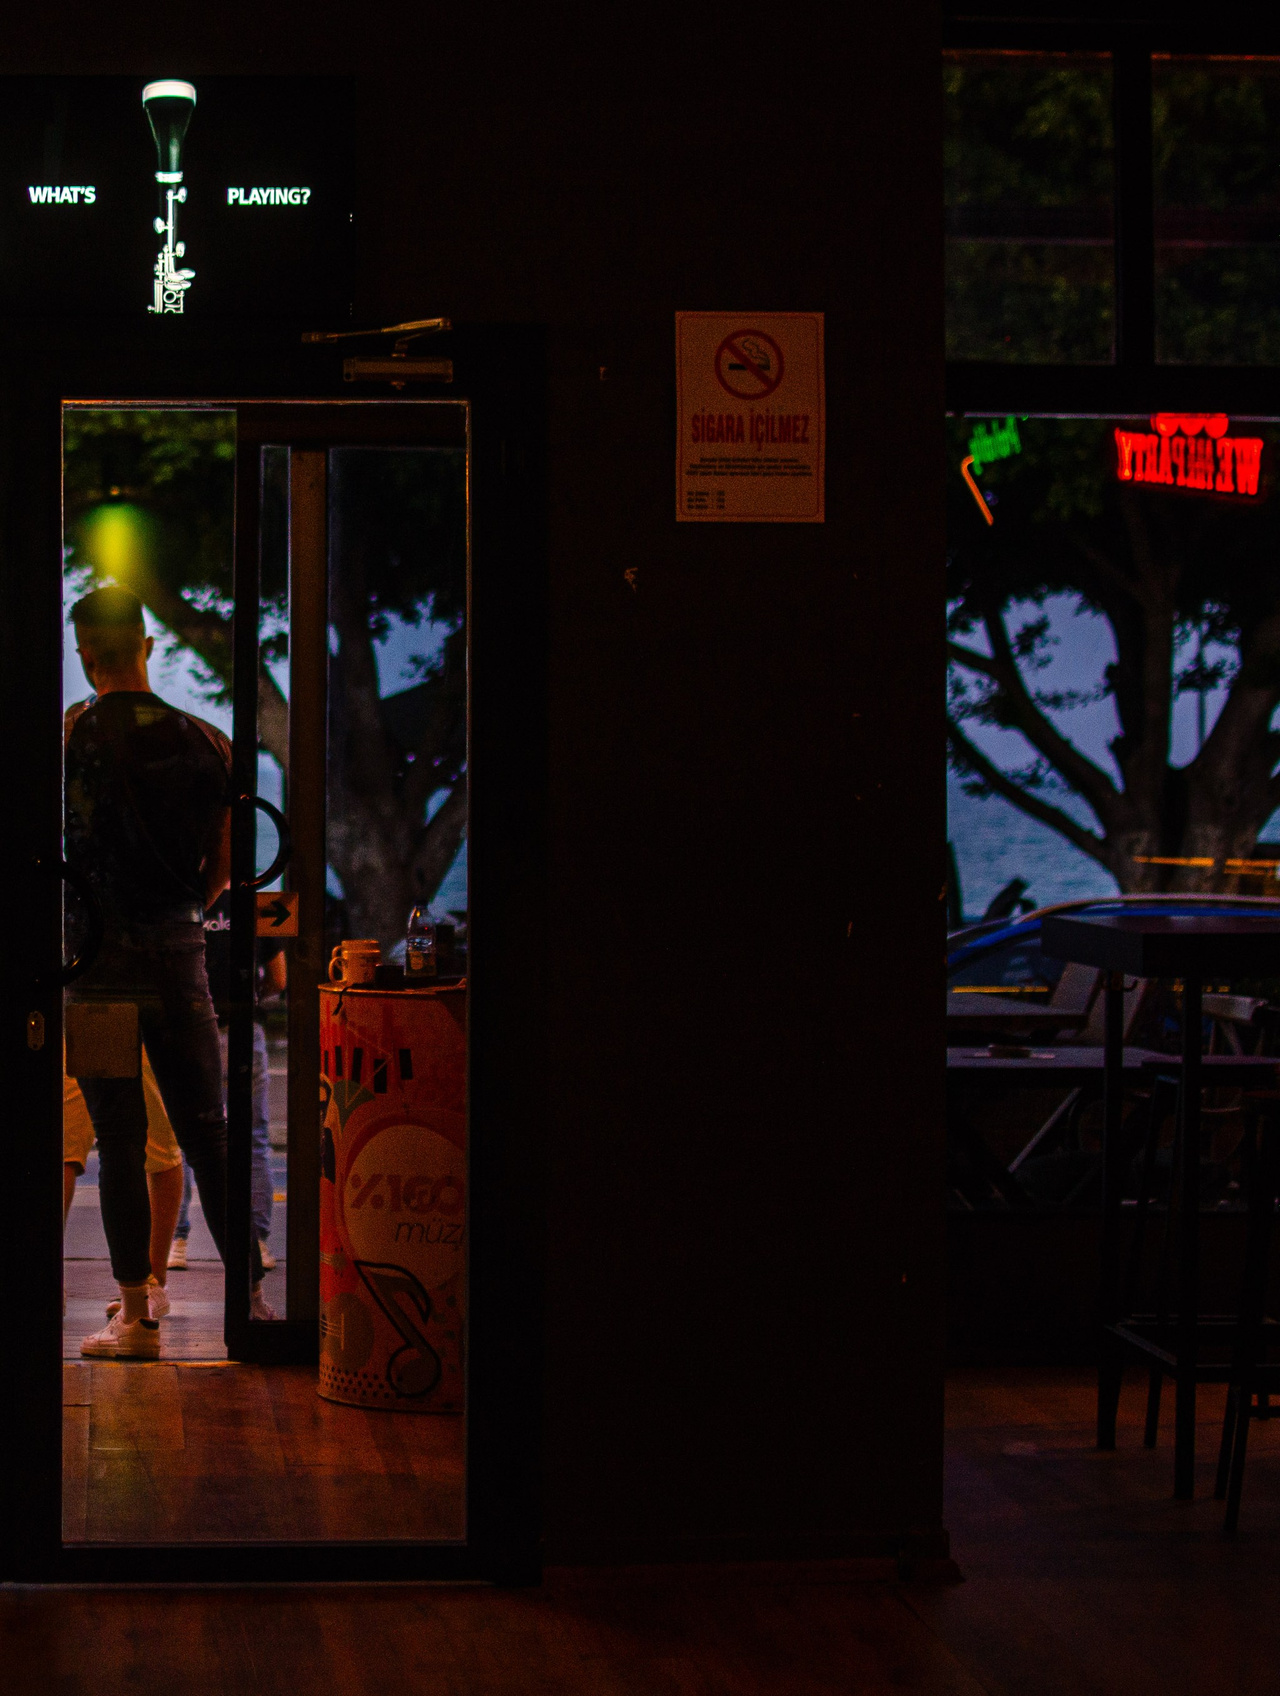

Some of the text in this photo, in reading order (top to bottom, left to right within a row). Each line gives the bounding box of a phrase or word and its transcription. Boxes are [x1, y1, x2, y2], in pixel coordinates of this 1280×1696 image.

[28, 186, 96, 204] WHAT'S
[227, 187, 311, 205] PLAYING?
[691, 407, 809, 451] SİGARA İÇİLMEZ
